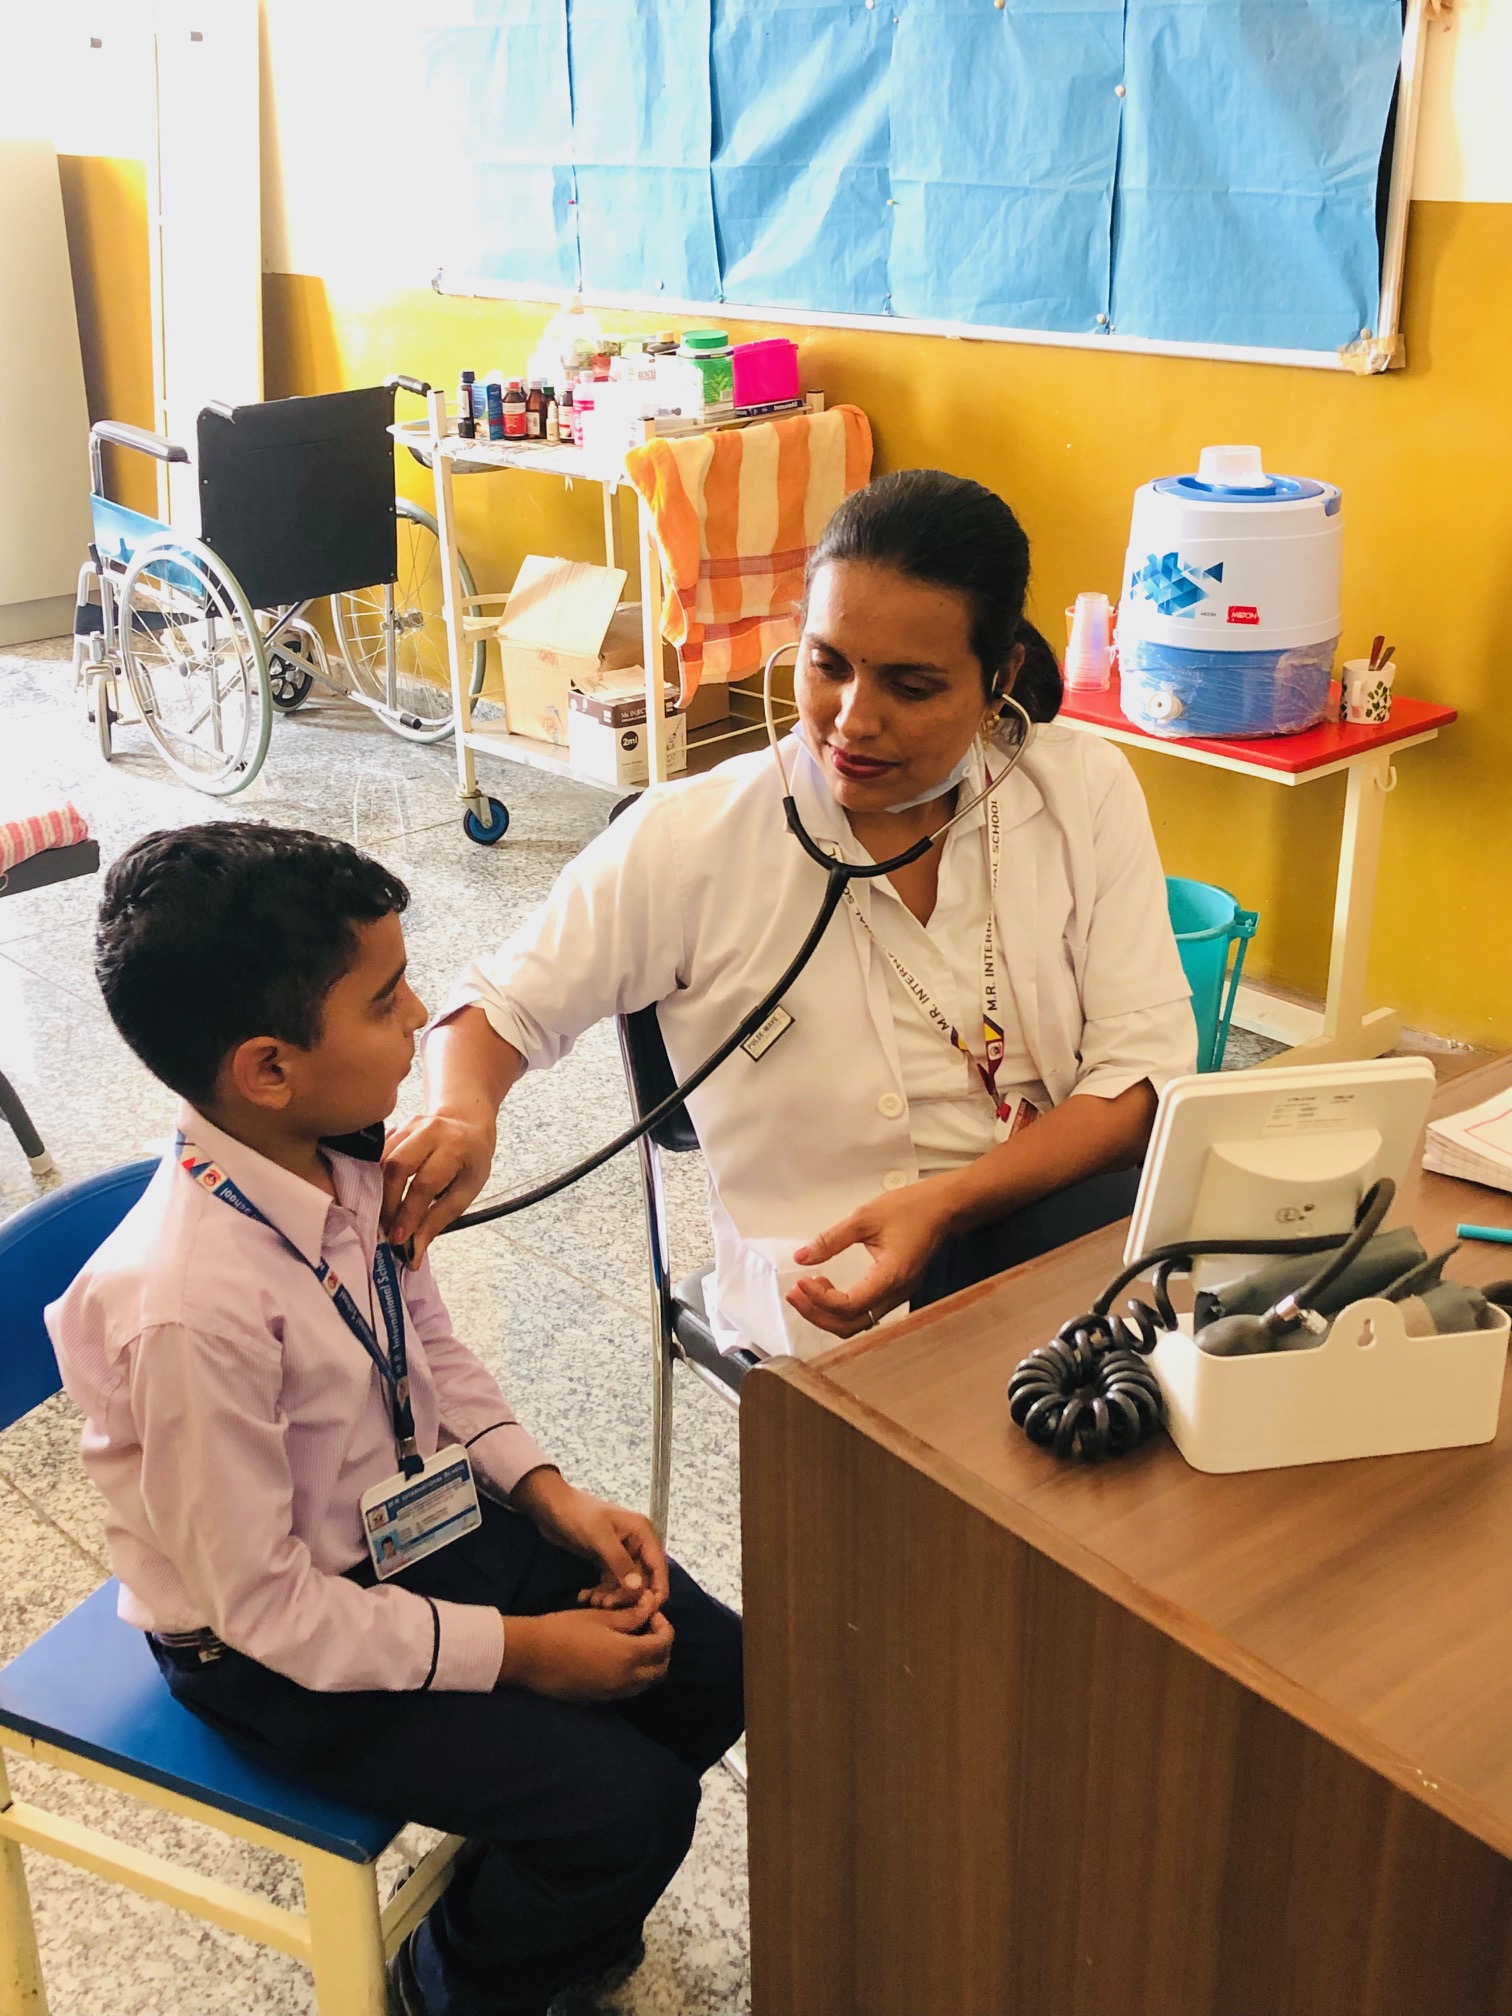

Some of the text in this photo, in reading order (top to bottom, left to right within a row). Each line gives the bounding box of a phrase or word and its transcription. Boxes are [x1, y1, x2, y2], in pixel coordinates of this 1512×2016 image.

[1231, 611, 1257, 619] MILTON
[622, 736, 638, 746] 2ml
[985, 982, 998, 1011] M.R.
[929, 1003, 950, 1031] M.R.
